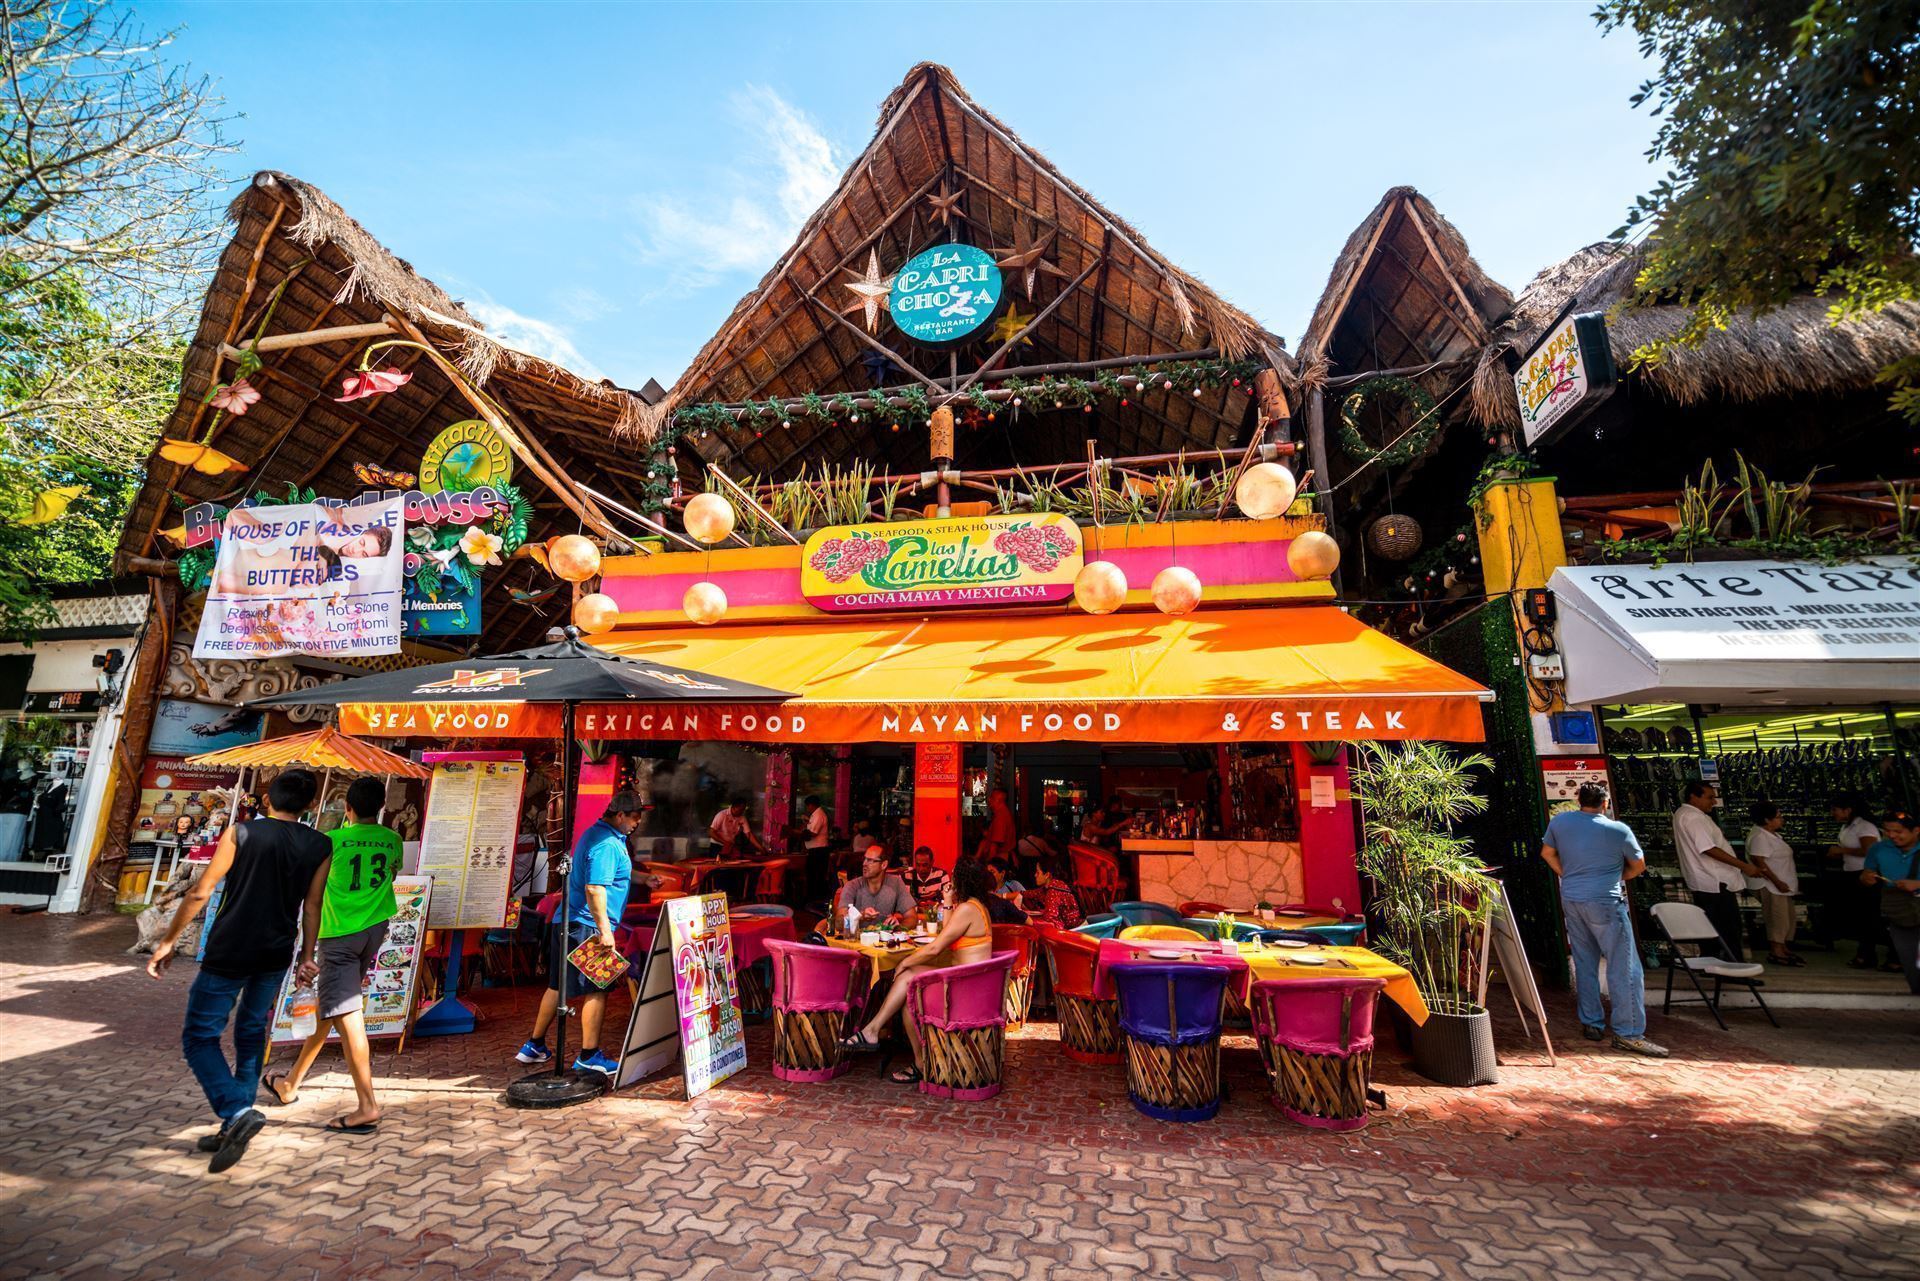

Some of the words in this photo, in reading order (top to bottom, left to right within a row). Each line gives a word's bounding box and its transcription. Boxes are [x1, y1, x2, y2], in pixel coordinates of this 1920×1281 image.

[931, 251, 962, 268] LA
[897, 264, 990, 293] CAPRI
[897, 285, 995, 318] CHOZA
[914, 318, 976, 331] RESTAURANTE
[935, 327, 954, 336] BAR
[1529, 324, 1573, 382] CAPRI
[1528, 353, 1578, 410] CHOZA
[421, 421, 508, 484] attraction
[363, 486, 499, 525] ouse
[229, 522, 283, 541] HOUSE
[285, 520, 310, 537] OF
[315, 510, 399, 538] ASSE
[872, 526, 926, 538] SEAFOOD
[926, 527, 933, 535] &
[935, 524, 970, 534] STEAK
[971, 522, 1011, 532] HOUSE
[290, 546, 321, 562] THE
[929, 540, 956, 556] las
[861, 535, 1022, 590] Camelias
[1590, 573, 1763, 600] Arte
[834, 592, 896, 606] COCINA
[898, 590, 941, 603] MAYA
[946, 589, 955, 601] Y
[957, 585, 1047, 600] MEXICANA
[326, 604, 350, 616] Hot
[410, 598, 464, 611] Memories
[1625, 606, 1696, 618] SILVER
[1693, 605, 1780, 618] FACTORY
[1789, 603, 1866, 615] WHOLE
[1860, 602, 1917, 614] SALE
[219, 622, 250, 638] Deep
[328, 619, 359, 633] Lomi
[1733, 620, 1779, 631] THE
[1774, 618, 1830, 631] BEST
[1826, 616, 1920, 629] SELECTIO
[203, 640, 233, 651] FREE
[235, 640, 321, 651] DEMONSTRATION
[323, 639, 349, 650] FIVE
[351, 635, 399, 648] MINUTES
[1840, 632, 1919, 645] SILVER
[48, 700, 59, 709] GET
[58, 695, 64, 709] 1
[62, 692, 82, 705] FREE
[369, 712, 417, 729] SEA
[433, 712, 510, 730] FOOD
[720, 714, 806, 734] FOOD
[881, 713, 998, 733] MAYAN
[1021, 711, 1122, 732] FOOD
[1221, 711, 1241, 733] &
[1269, 710, 1406, 733] STEAK
[342, 840, 394, 850] CHINA
[349, 853, 388, 891] 13
[697, 898, 725, 917] APPY
[706, 913, 727, 928] HOUR
[678, 934, 739, 1018] 2X1
